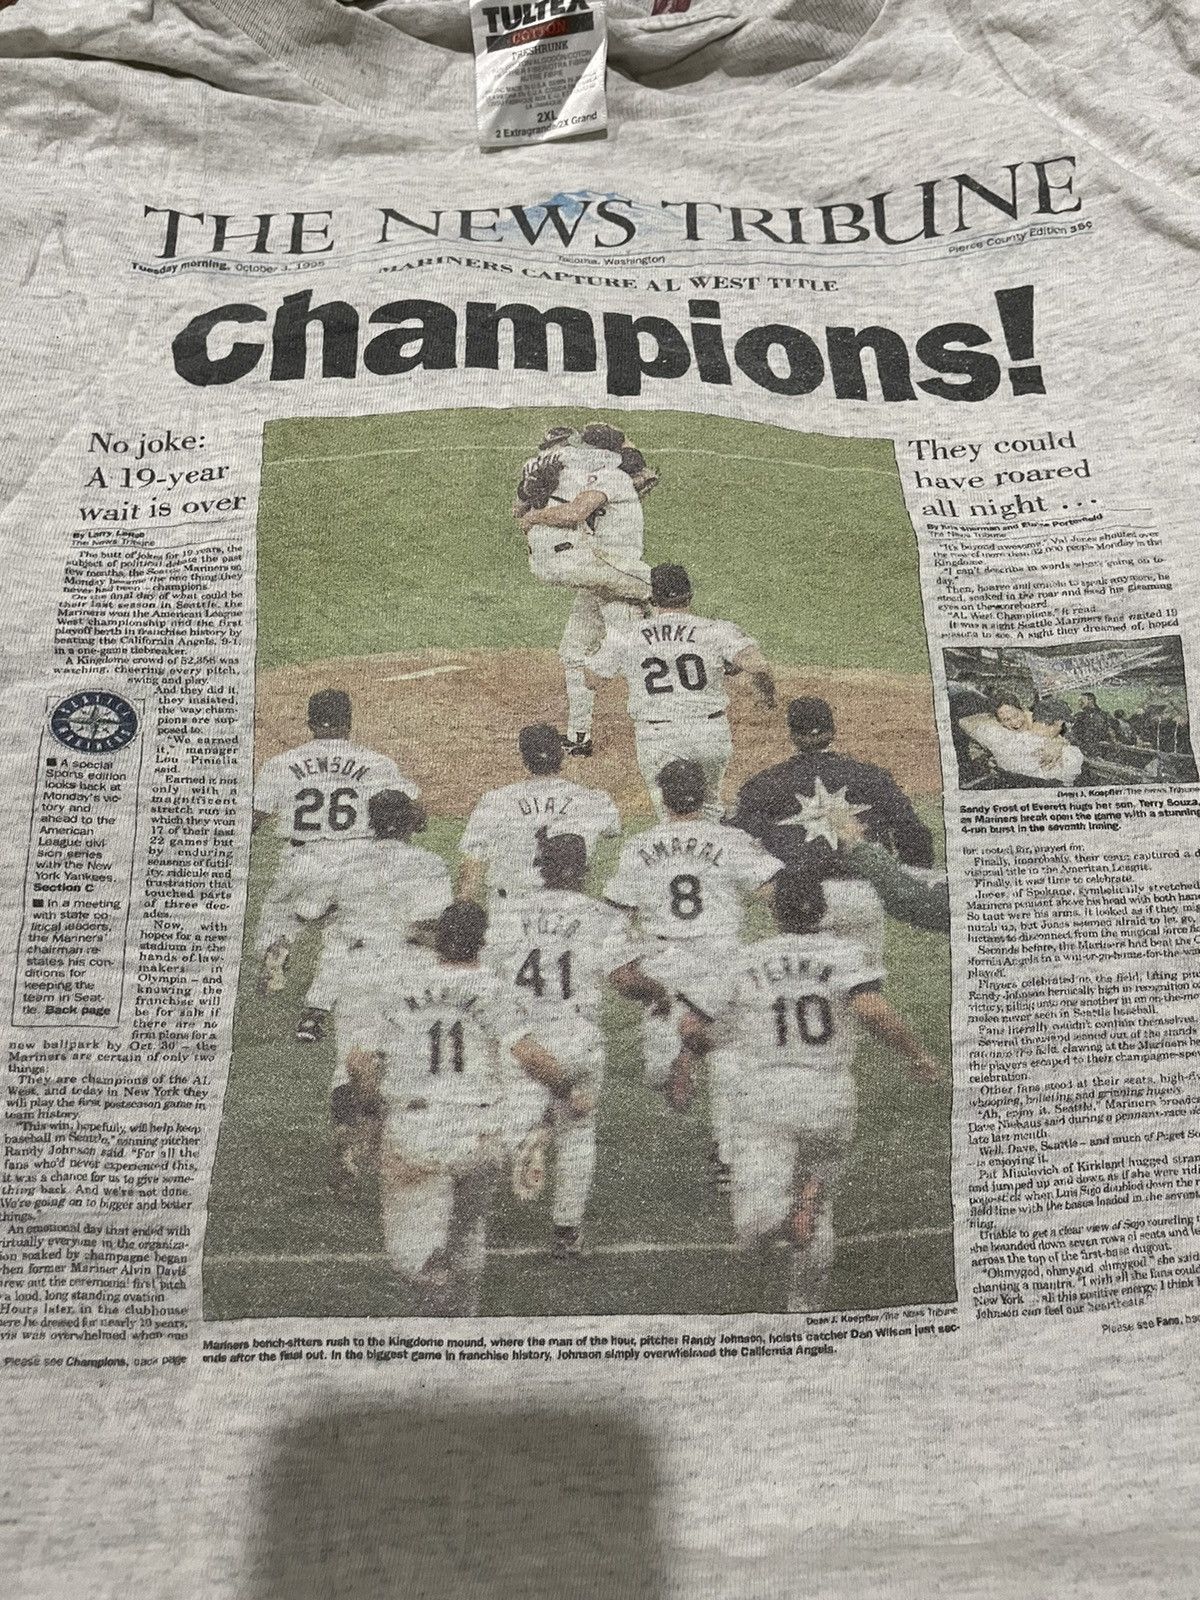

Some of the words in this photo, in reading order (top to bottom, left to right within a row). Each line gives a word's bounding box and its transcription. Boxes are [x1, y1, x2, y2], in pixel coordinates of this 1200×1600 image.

[495, 129, 502, 138] 2
[571, 111, 598, 125] Grand
[537, 110, 558, 123] 2XL
[144, 205, 335, 258] THE
[375, 199, 636, 249] NEWS
[661, 156, 1083, 245] TRIBUNE
[948, 241, 984, 254] Pierce
[986, 231, 1028, 248] County
[1029, 227, 1068, 238] Edition
[132, 262, 179, 275] Tuesday
[180, 259, 231, 271] morning,
[236, 263, 278, 273] October
[604, 255, 666, 266] Washington
[379, 256, 514, 273] MARINERS
[522, 267, 637, 288] CAPTURE
[646, 278, 681, 292] AL
[688, 276, 760, 290] WEST
[768, 277, 839, 291] TITLE
[171, 285, 1046, 401] champions!
[88, 432, 129, 454] No
[135, 430, 206, 460] joke:
[908, 439, 982, 462] They
[994, 430, 1077, 454] could
[84, 466, 108, 488] A
[120, 465, 230, 491] 19-year
[914, 470, 985, 489] have
[996, 459, 1091, 487] roared
[79, 501, 141, 521] wait
[149, 497, 172, 518] is
[182, 496, 247, 514] over
[922, 499, 960, 518] all
[970, 494, 1048, 520] night
[73, 532, 85, 540] By
[927, 523, 939, 531] By
[99, 636, 117, 645] the
[120, 636, 174, 646] California
[641, 624, 698, 645] PIRKL
[640, 653, 708, 695] 20
[180, 686, 203, 696] they
[207, 685, 224, 694] did
[289, 755, 371, 781] NEWSON
[293, 787, 359, 831] 26
[517, 796, 573, 816] DIAZ
[960, 805, 990, 815] Sandy
[993, 804, 1018, 813] Frost
[1020, 803, 1029, 811] of
[1032, 803, 1067, 811] Everett
[1069, 802, 1093, 811] hugs
[1095, 802, 1112, 810] her
[1138, 799, 1164, 808] Terry
[975, 815, 1018, 824] Mariners
[1075, 812, 1092, 820] the
[1094, 812, 1121, 821] game
[1124, 810, 1147, 818] with
[1158, 808, 1200, 818] stunning
[961, 826, 987, 834] 4-run
[990, 825, 1015, 833] burst
[1018, 824, 1027, 832] in
[1029, 824, 1045, 832] the
[33, 883, 81, 892] Section
[85, 884, 94, 893] C
[669, 874, 702, 921] 8
[515, 948, 573, 1000] 41
[45, 1005, 77, 1014] Back
[81, 1006, 111, 1016] page
[773, 994, 834, 1047] 10
[428, 1020, 464, 1074] 11
[1008, 1253, 1026, 1264] the
[1028, 1252, 1046, 1266] top
[1131, 1241, 1172, 1256] dugout.
[203, 1340, 250, 1350] Mariners
[252, 1338, 323, 1348] bench-sitters
[326, 1337, 350, 1346] rush
[353, 1338, 365, 1346] to
[367, 1337, 386, 1346] the
[389, 1336, 444, 1349] Kingdome
[447, 1337, 487, 1348] mound,
[490, 1337, 524, 1347] where
[527, 1337, 545, 1346] the
[549, 1338, 572, 1347] man
[576, 1336, 587, 1346] of
[590, 1336, 608, 1346] the
[611, 1335, 637, 1347] hour,
[640, 1335, 678, 1347] pitcher
[682, 1334, 716, 1347] Randy
[720, 1333, 765, 1345] Johnson,
[769, 1333, 802, 1343] hoists
[806, 1330, 848, 1342] catcher
[850, 1328, 873, 1339] Dan
[875, 1327, 911, 1338] Wilson
[915, 1324, 935, 1337] just
[938, 1324, 960, 1333] sec-
[1101, 1323, 1134, 1335] Please
[4, 1355, 40, 1366] Please
[44, 1357, 63, 1366] see
[65, 1356, 129, 1368] Champions,
[162, 1354, 187, 1366] page
[203, 1352, 227, 1363] ends
[229, 1351, 255, 1363] after
[258, 1351, 276, 1361] the
[306, 1350, 327, 1361] out.
[331, 1350, 341, 1360] In
[345, 1350, 363, 1360] the
[366, 1350, 408, 1362] biggest
[411, 1350, 442, 1362] game
[445, 1350, 455, 1361] in
[458, 1350, 509, 1361] franchise
[557, 1348, 601, 1360] Johnson
[604, 1348, 640, 1361] simply
[720, 1347, 738, 1357] the
